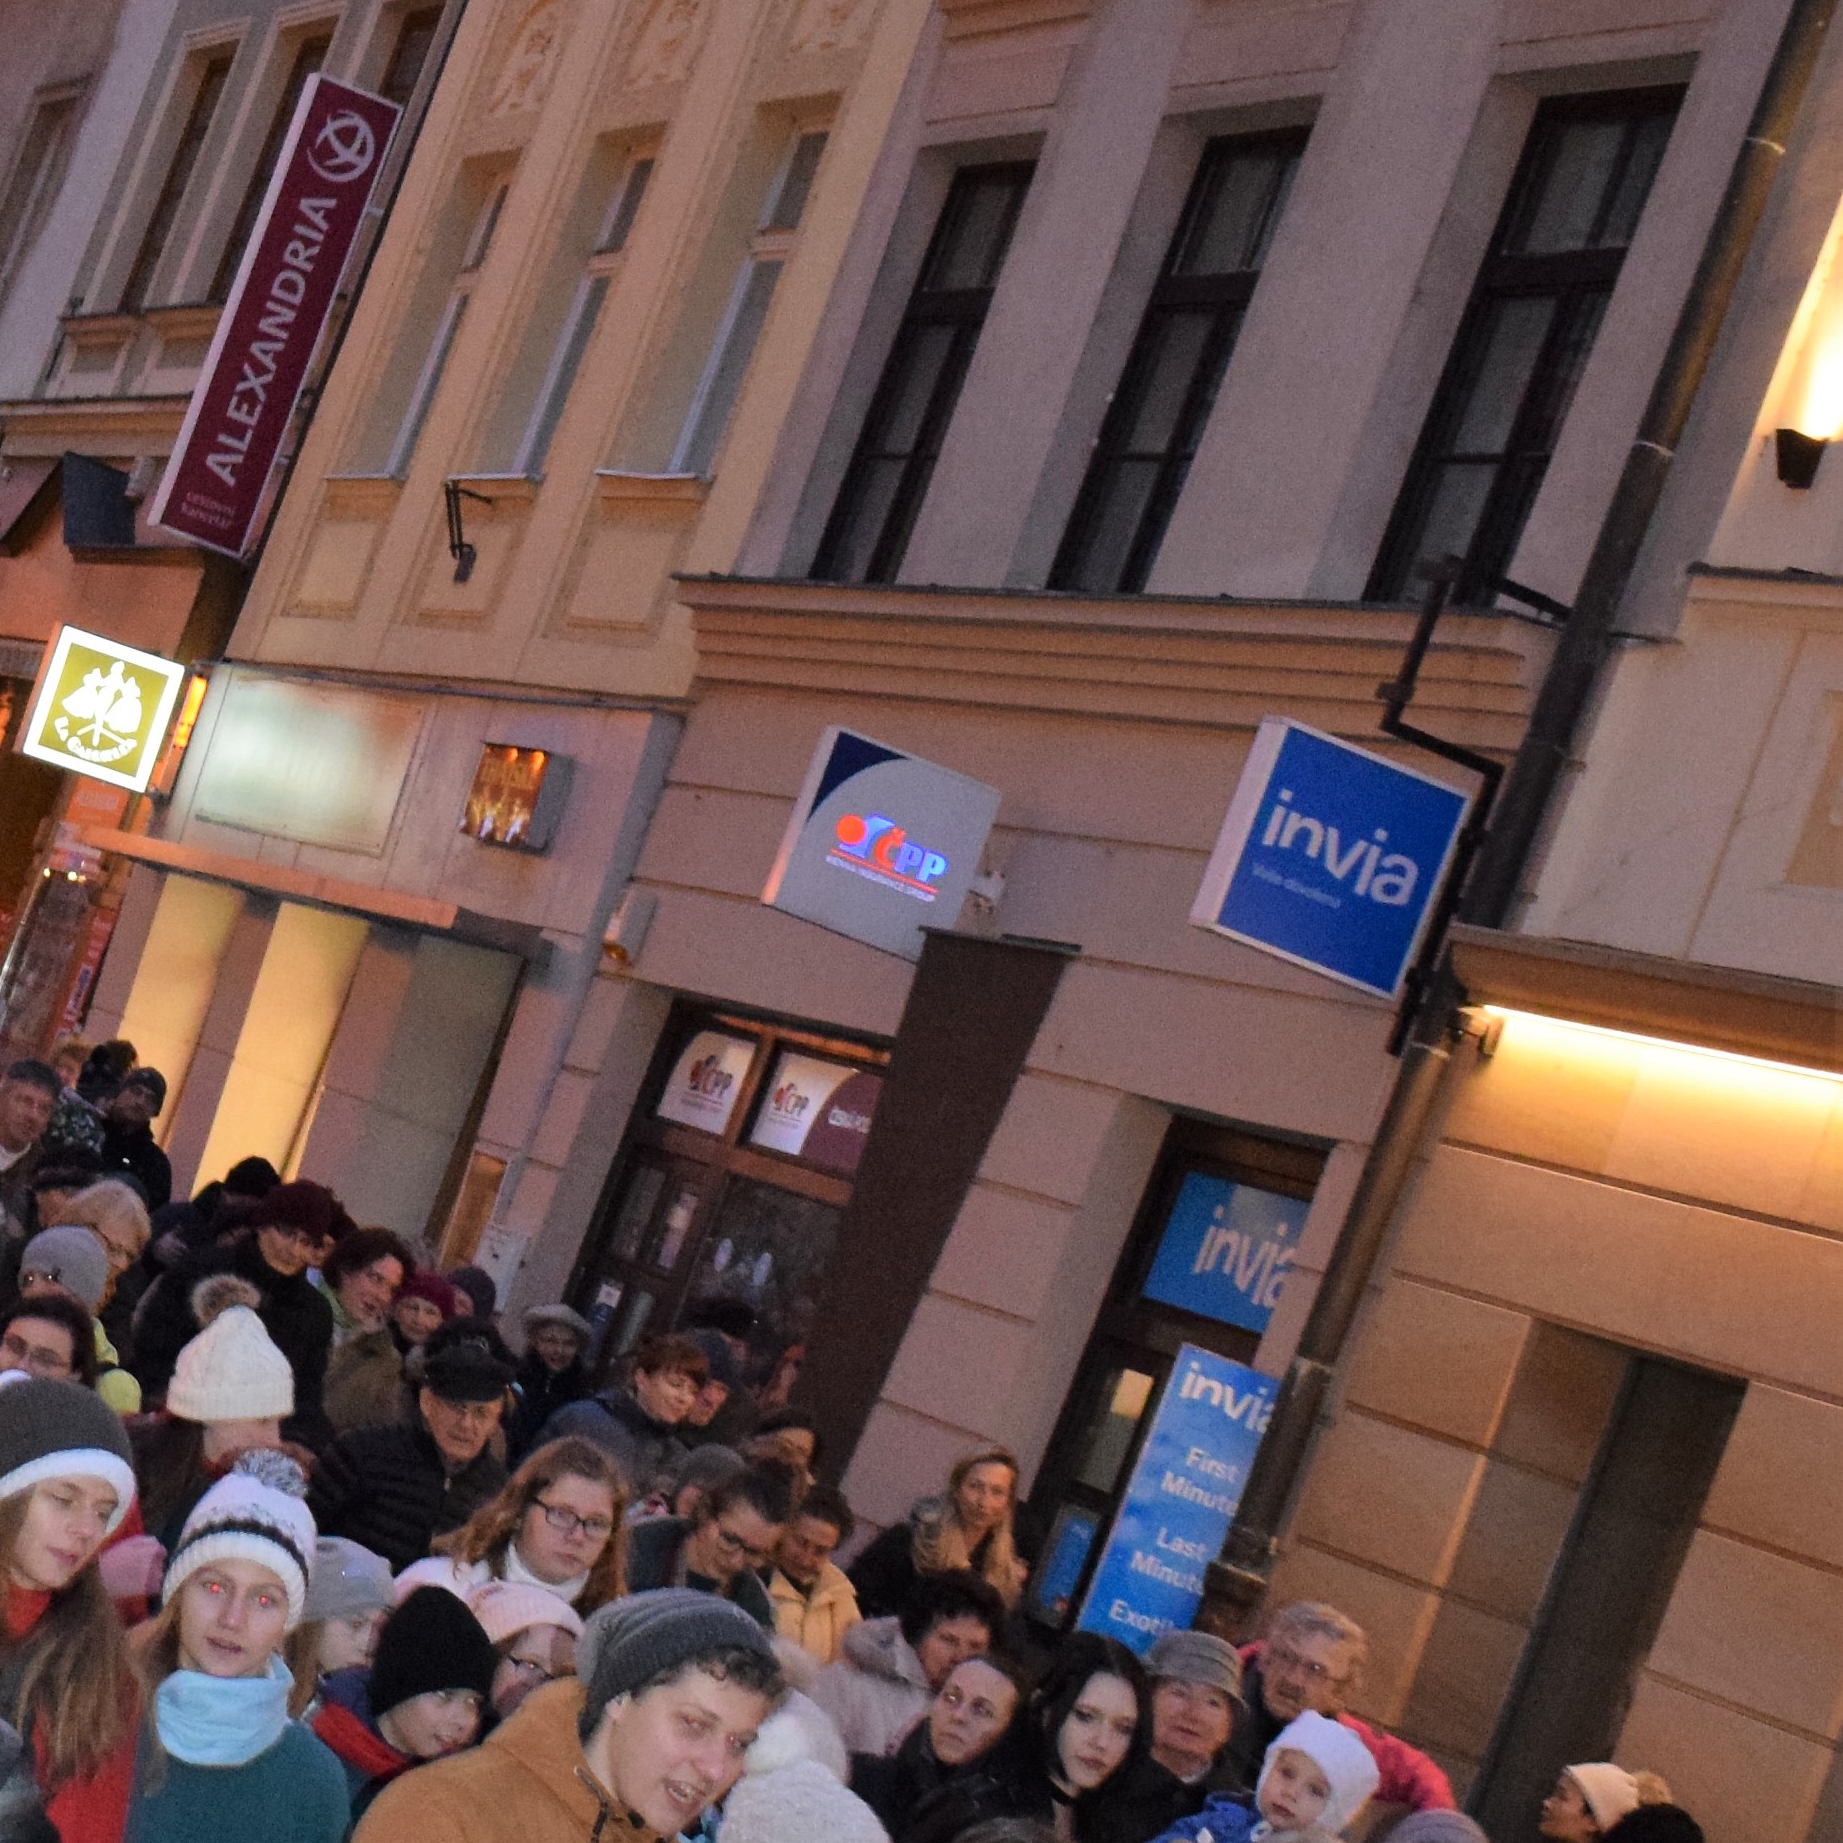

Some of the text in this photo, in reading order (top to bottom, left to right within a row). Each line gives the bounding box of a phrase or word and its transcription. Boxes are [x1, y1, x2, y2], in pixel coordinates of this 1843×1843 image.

[206, 197, 337, 487] ALEXANDRIA
[873, 827, 949, 885] ČPP
[1262, 788, 1419, 906] invia
[1186, 1446, 1239, 1483] First
[1156, 1526, 1206, 1562] Last
